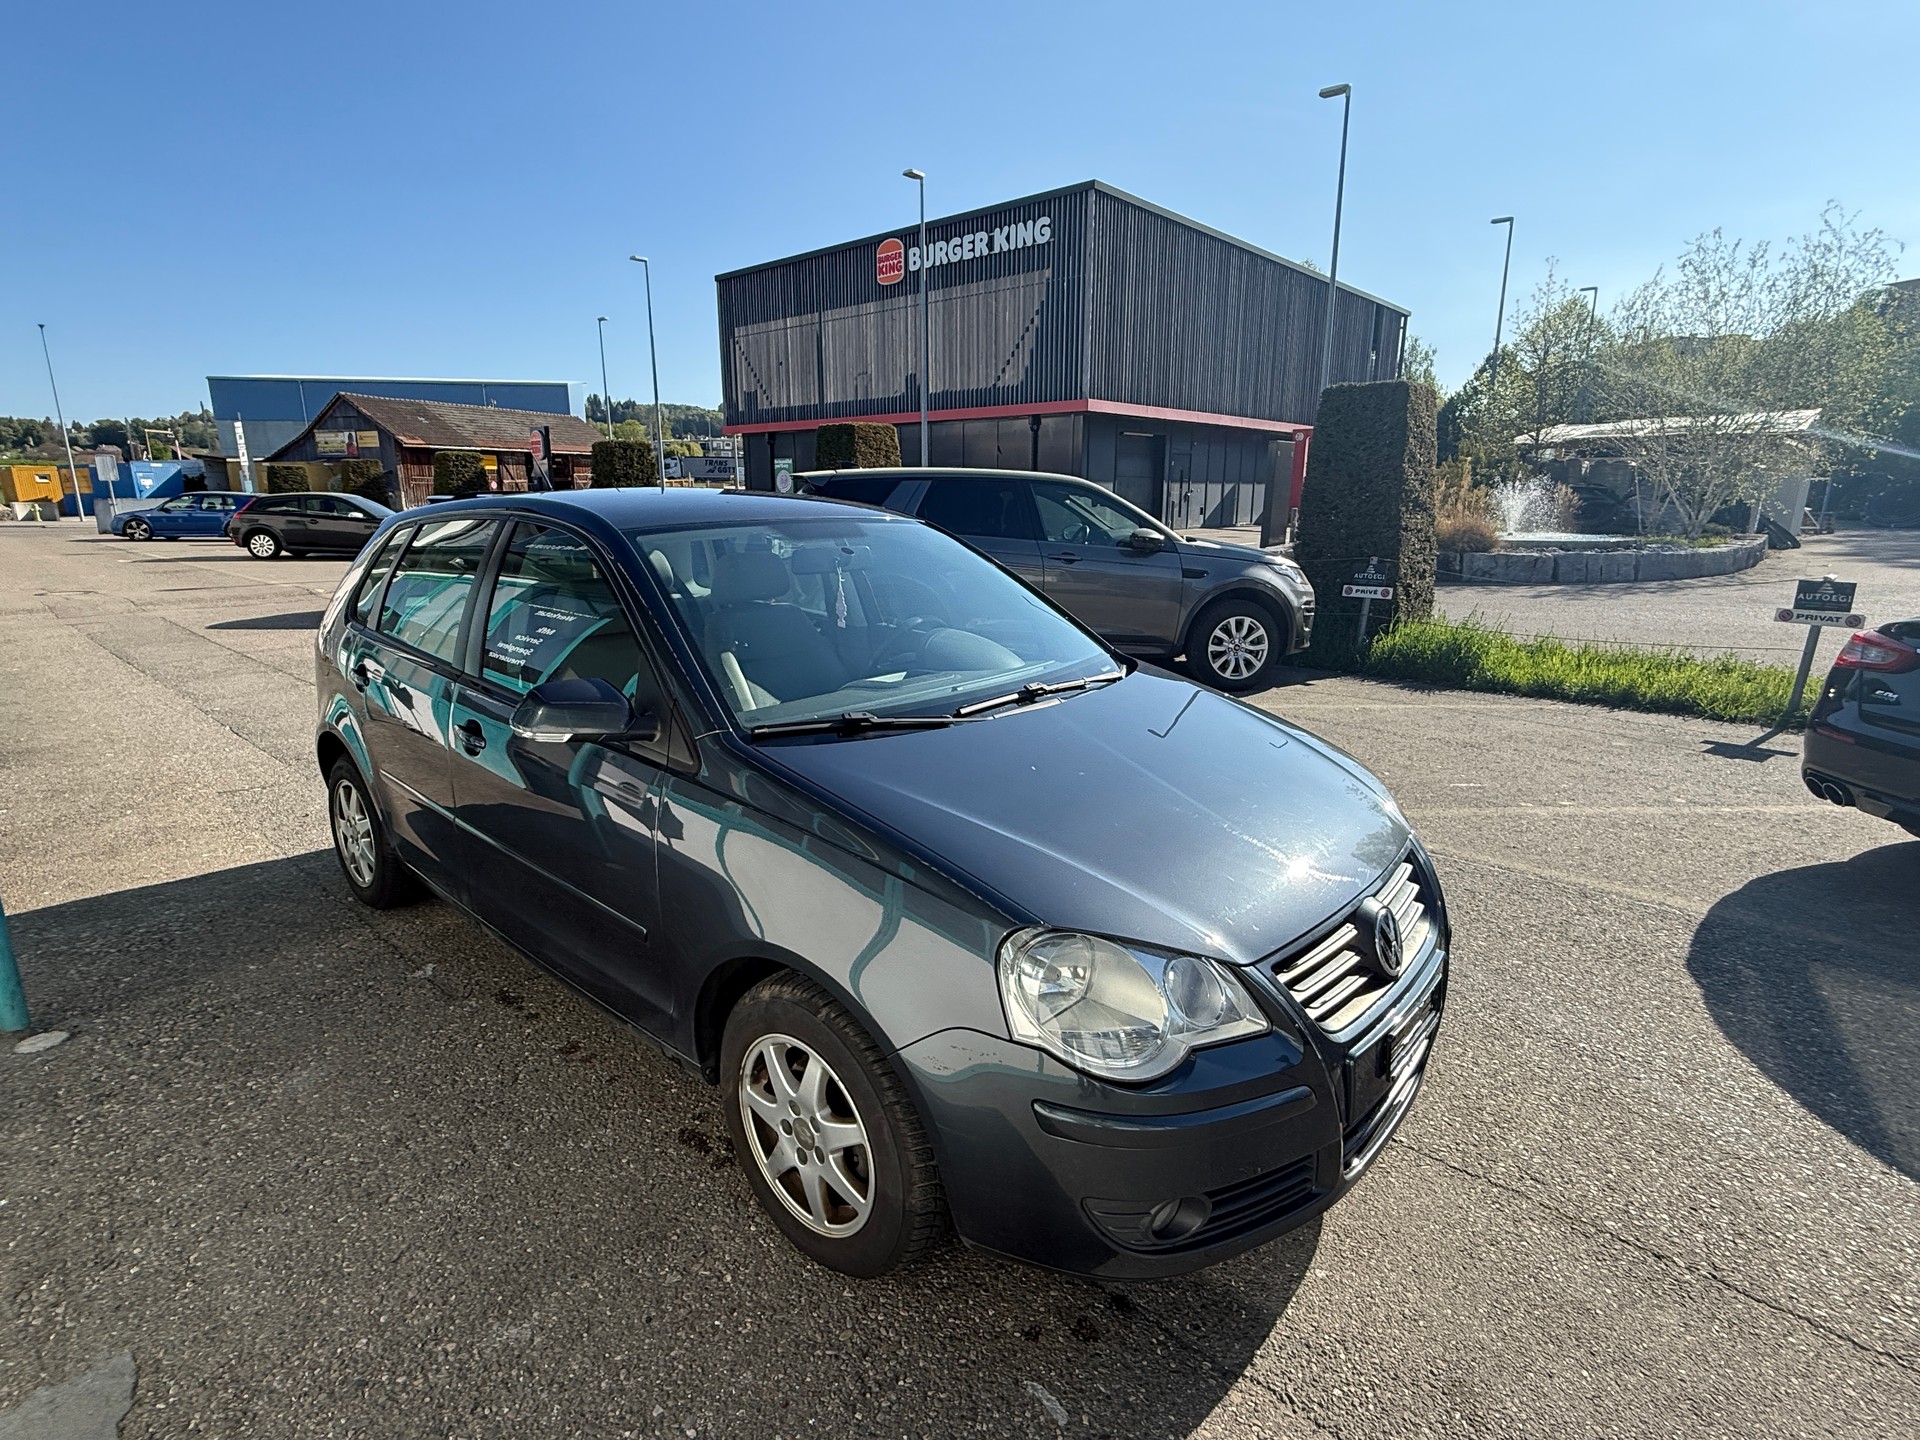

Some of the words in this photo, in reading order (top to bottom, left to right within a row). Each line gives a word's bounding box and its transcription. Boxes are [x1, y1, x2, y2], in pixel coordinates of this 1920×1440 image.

[908, 231, 989, 272] BURGER
[993, 216, 1052, 254] KING
[877, 251, 903, 264] BURGER
[878, 260, 903, 277] KING
[704, 459, 729, 467] TRANS
[1797, 592, 1853, 603] AUTOEGI
[1795, 613, 1843, 623] PRIVAT
